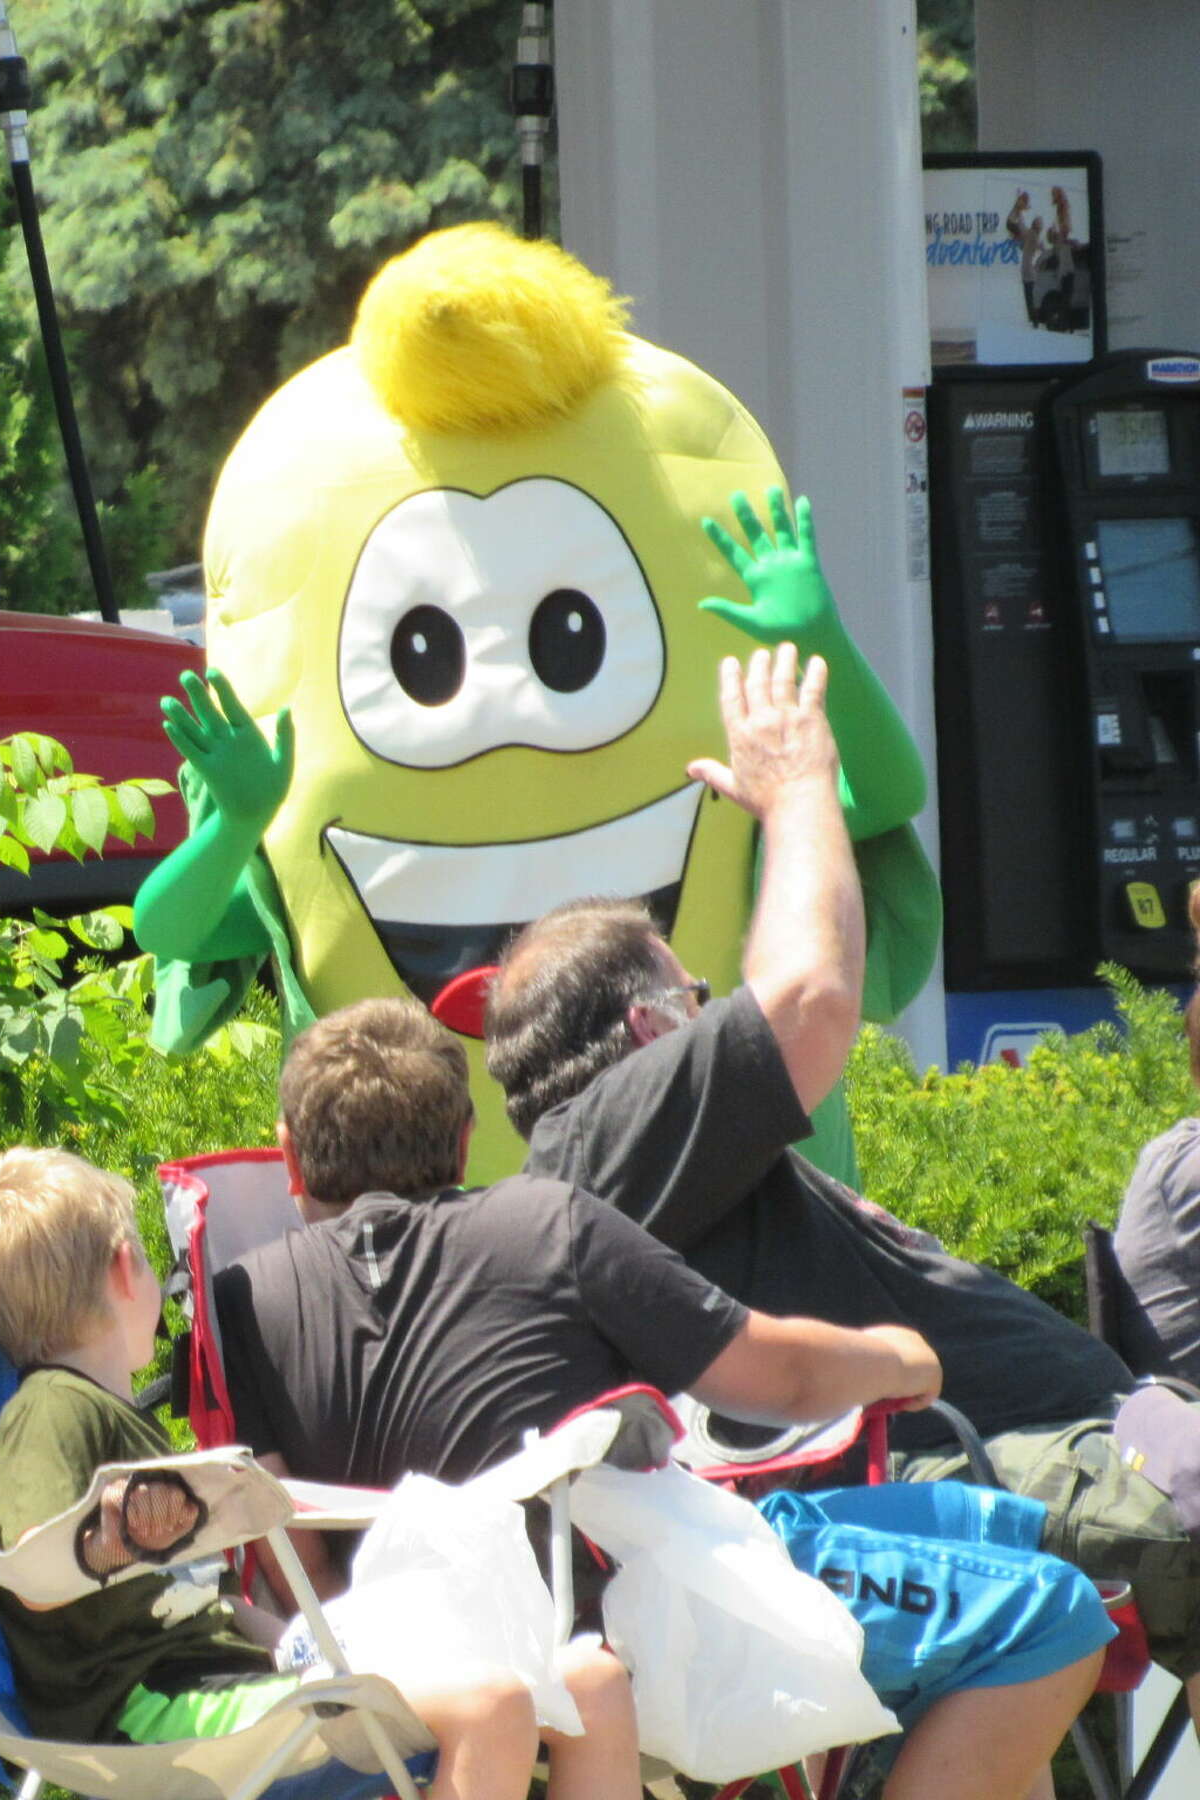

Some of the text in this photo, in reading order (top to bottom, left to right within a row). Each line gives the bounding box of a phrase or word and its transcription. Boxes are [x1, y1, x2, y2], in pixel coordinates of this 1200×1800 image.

[943, 212, 972, 234] ROAD
[976, 212, 1000, 233] TRIP
[975, 411, 1034, 429] WARNING
[1103, 848, 1158, 863] REGULAR
